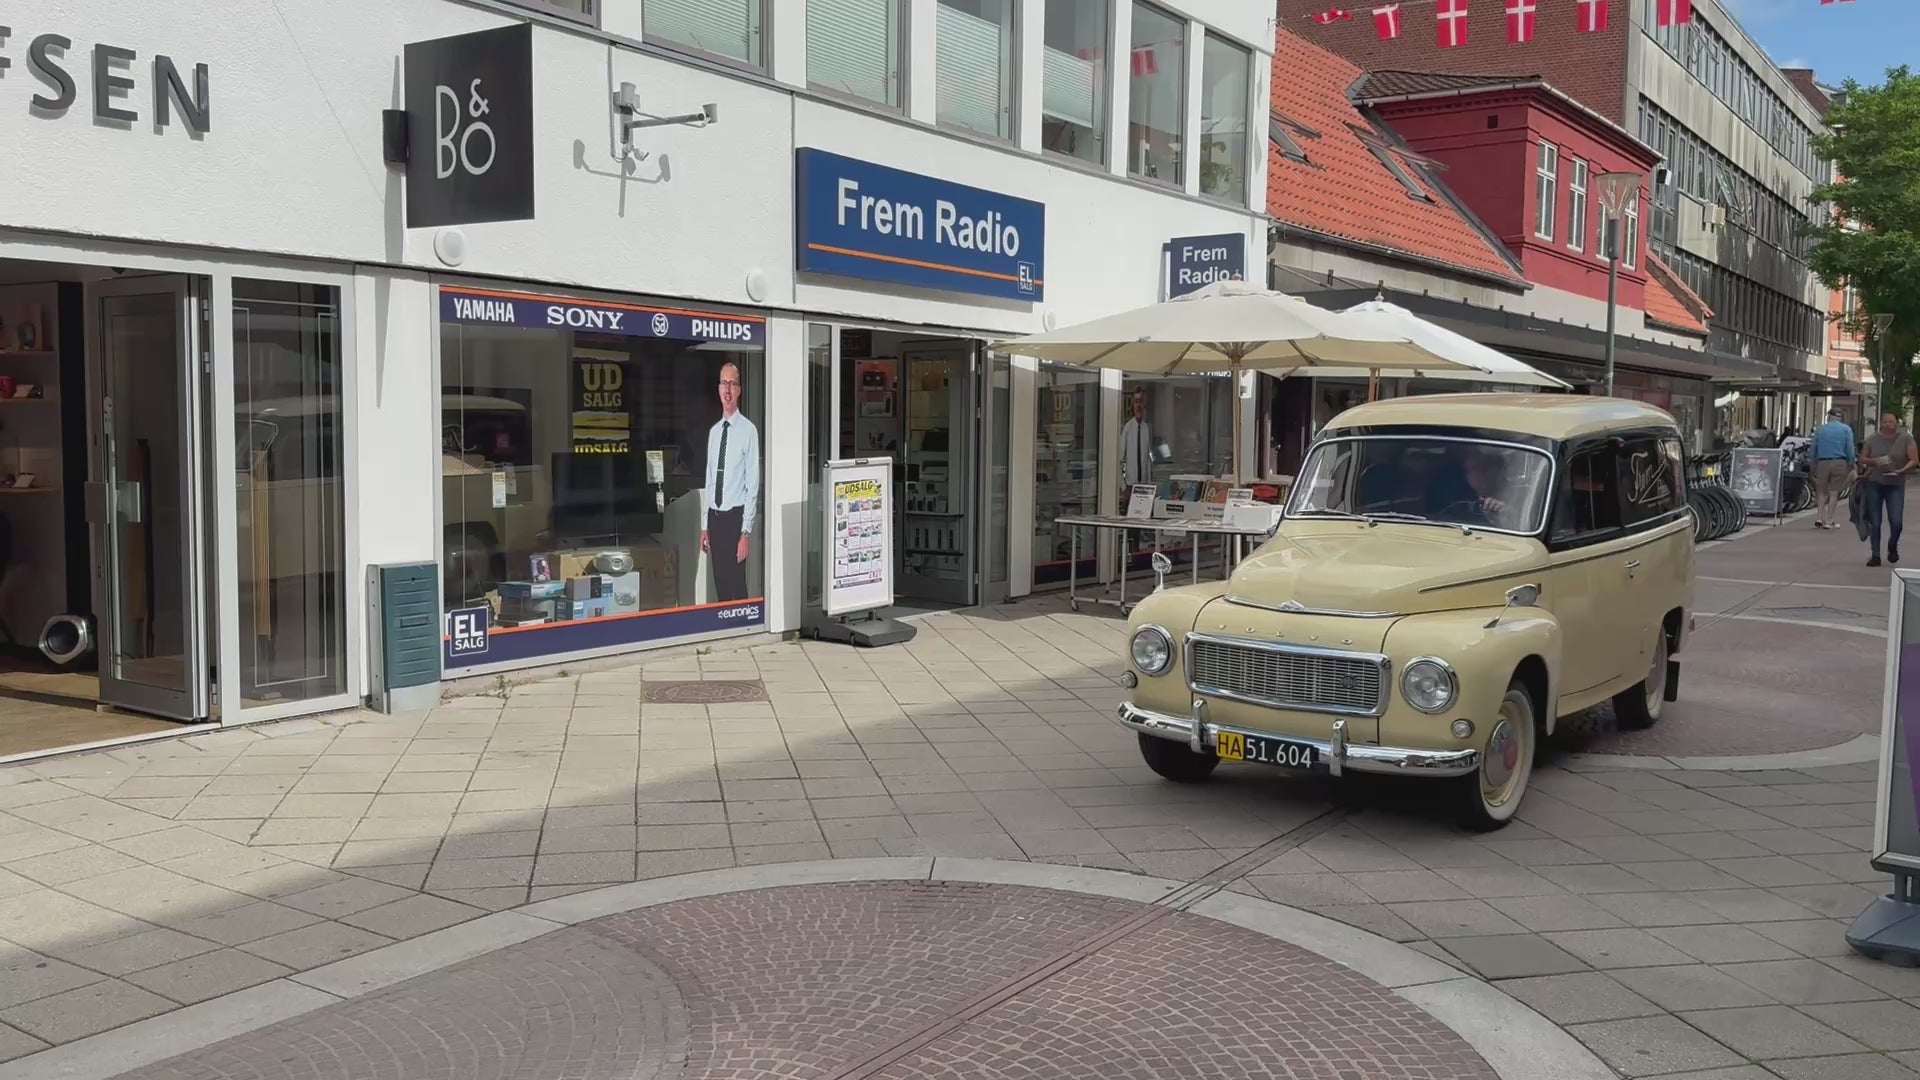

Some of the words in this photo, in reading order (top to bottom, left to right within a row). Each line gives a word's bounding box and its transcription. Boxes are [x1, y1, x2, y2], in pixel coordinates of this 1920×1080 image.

[0, 25, 210, 133] SEN
[838, 177, 923, 240] Frem
[936, 200, 1020, 257] Radio
[1183, 246, 1227, 263] Frem
[1020, 264, 1033, 283] EL
[1179, 266, 1230, 285] Radio
[453, 297, 515, 323] YAMAHA
[547, 306, 624, 330] SONY
[691, 319, 752, 341] PHILIPS
[581, 363, 622, 391] UD
[583, 392, 622, 408] SALG
[844, 481, 873, 494] UDSALG
[723, 604, 760, 619] euronics
[455, 614, 484, 639] EL
[455, 636, 484, 651] SALG
[1218, 734, 1242, 758] HA
[1246, 738, 1312, 768] 51.604
